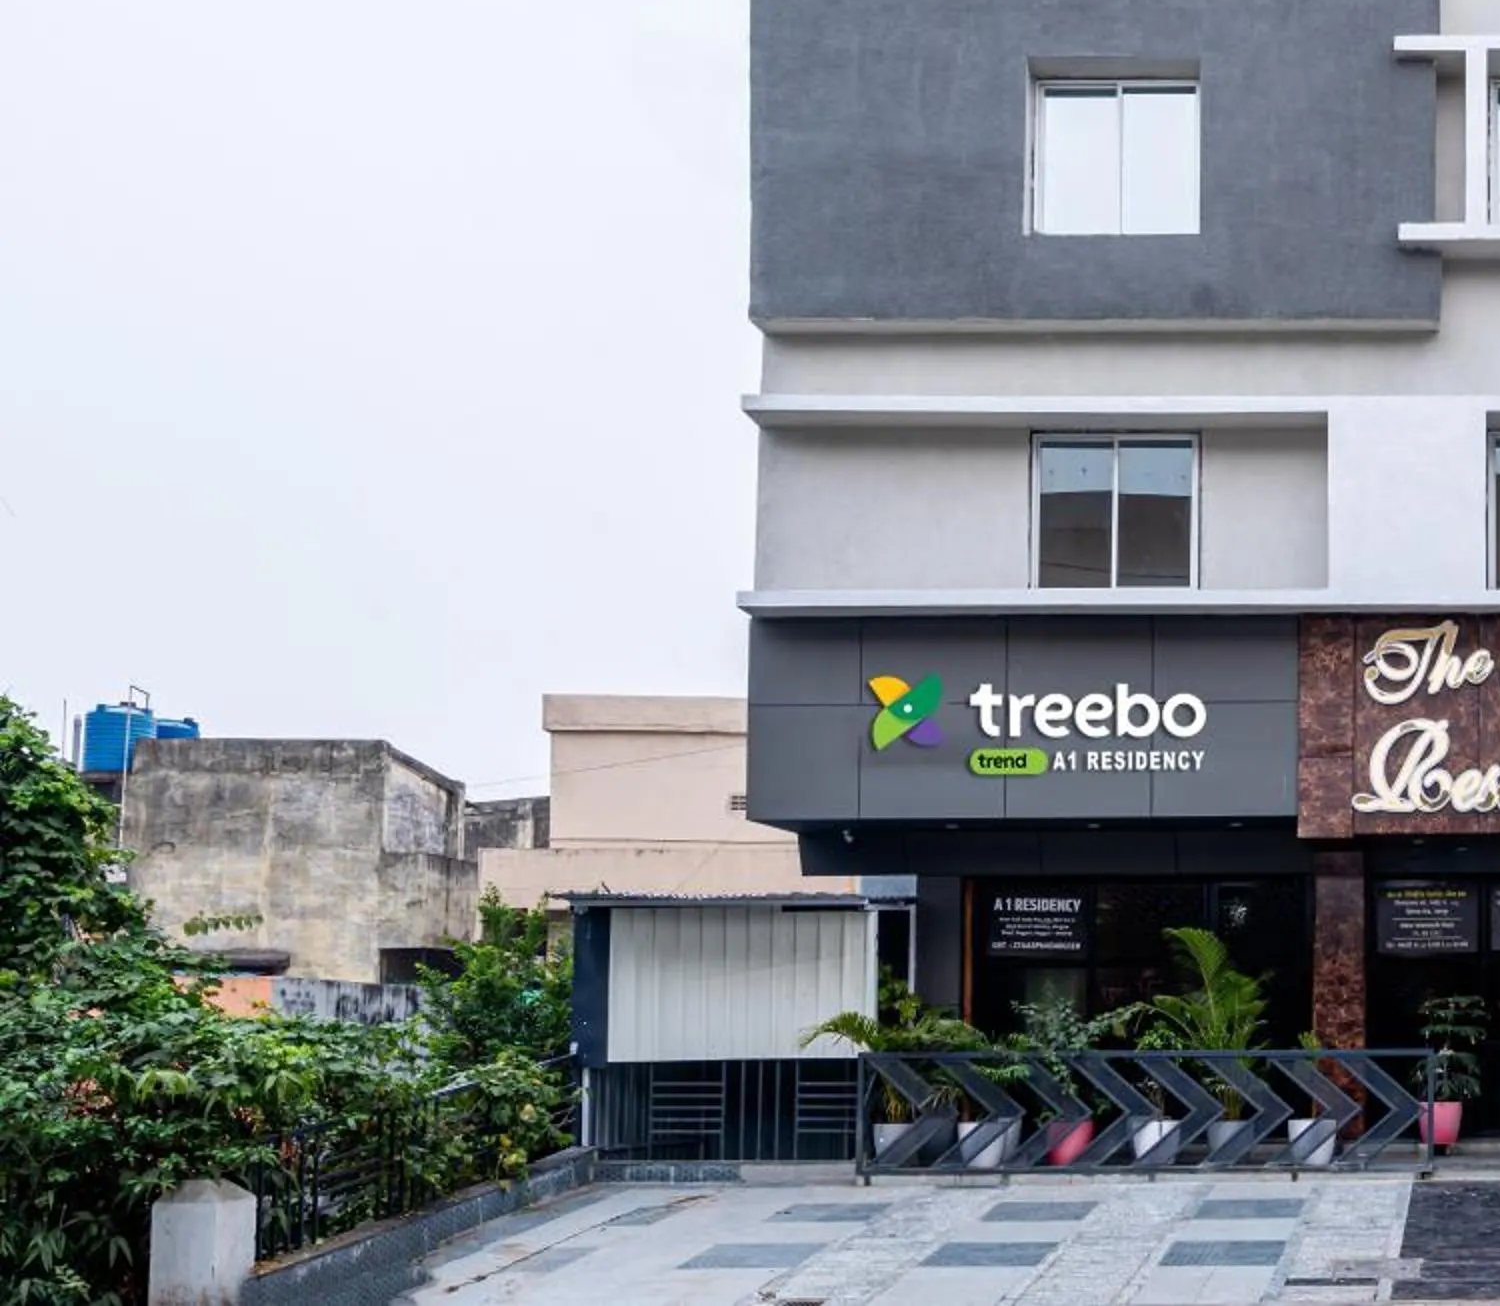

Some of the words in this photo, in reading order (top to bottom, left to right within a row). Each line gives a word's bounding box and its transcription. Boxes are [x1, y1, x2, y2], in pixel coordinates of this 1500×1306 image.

[1362, 619, 1495, 705] The
[969, 682, 1207, 738] treebo
[977, 753, 1028, 769] trend
[1053, 751, 1078, 771] A1
[1087, 750, 1206, 771] RESIDENCY
[1014, 897, 1081, 912] RESIDENCY
